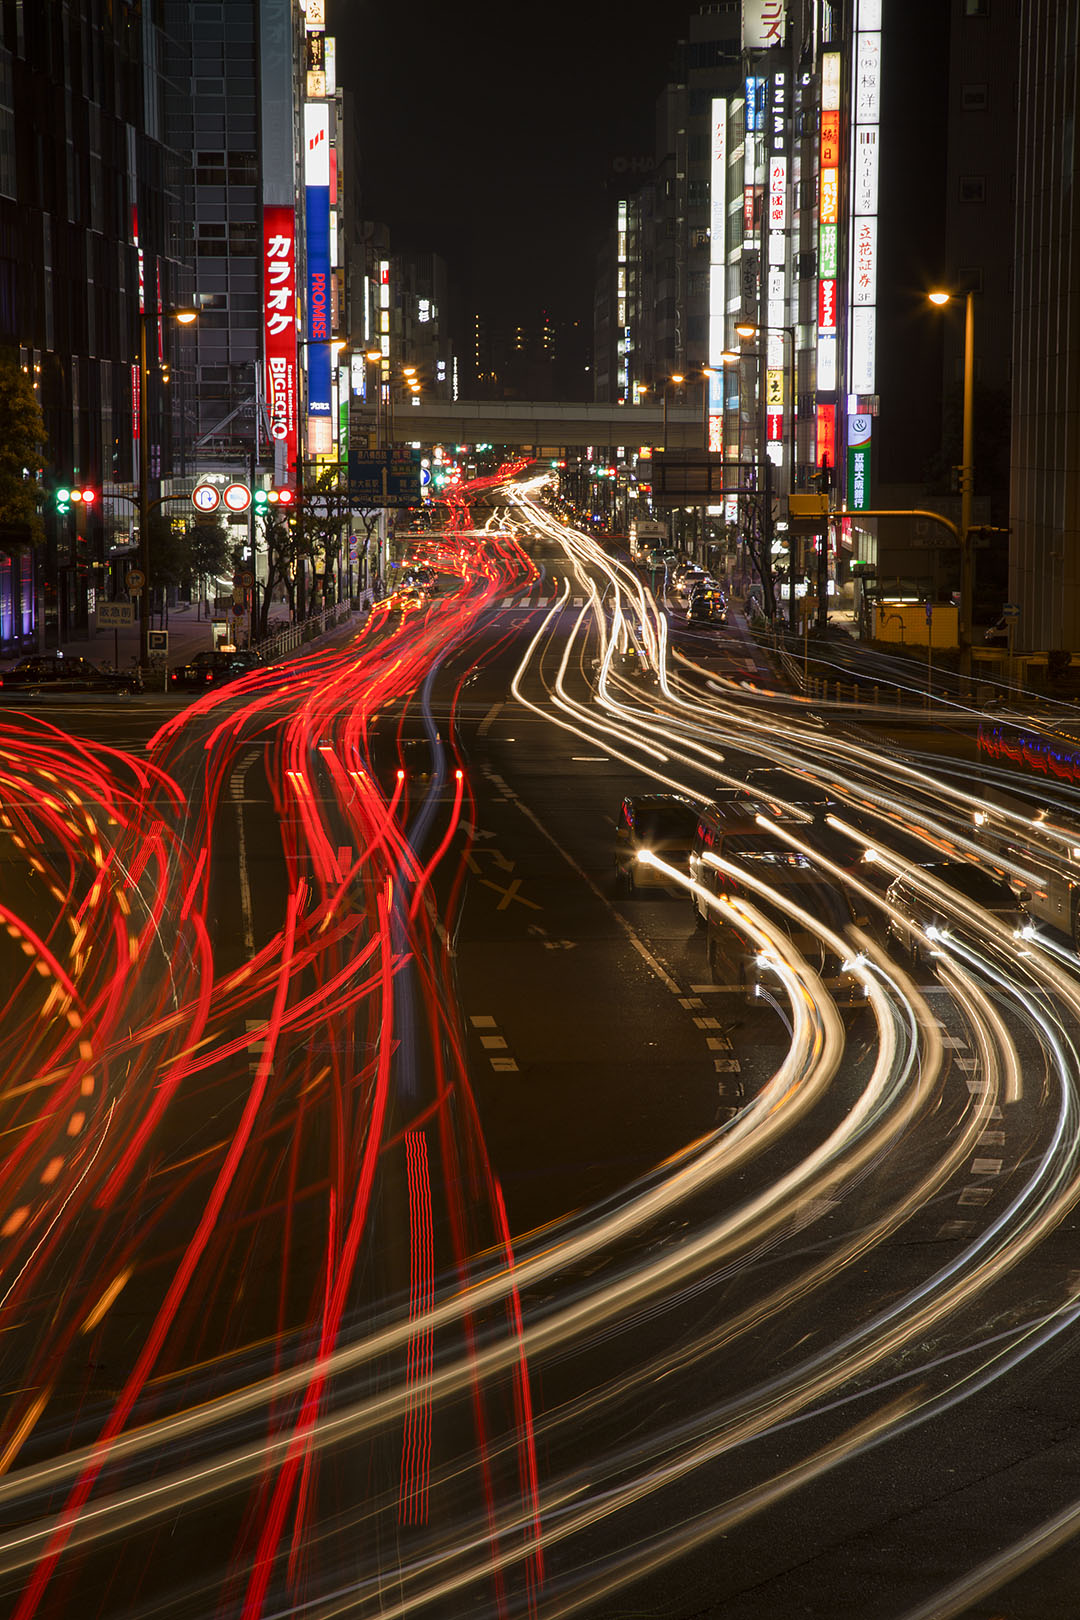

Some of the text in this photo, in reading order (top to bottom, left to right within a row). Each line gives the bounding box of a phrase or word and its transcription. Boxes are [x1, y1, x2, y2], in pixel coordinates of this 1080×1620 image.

[267, 234, 293, 336] カラオケ
[858, 224, 873, 288] 立花証券
[312, 273, 326, 339] PROMISE
[858, 293, 871, 302] 3F
[270, 357, 288, 441] BIG ECHO
[854, 453, 865, 509] 近畿大阪銀行
